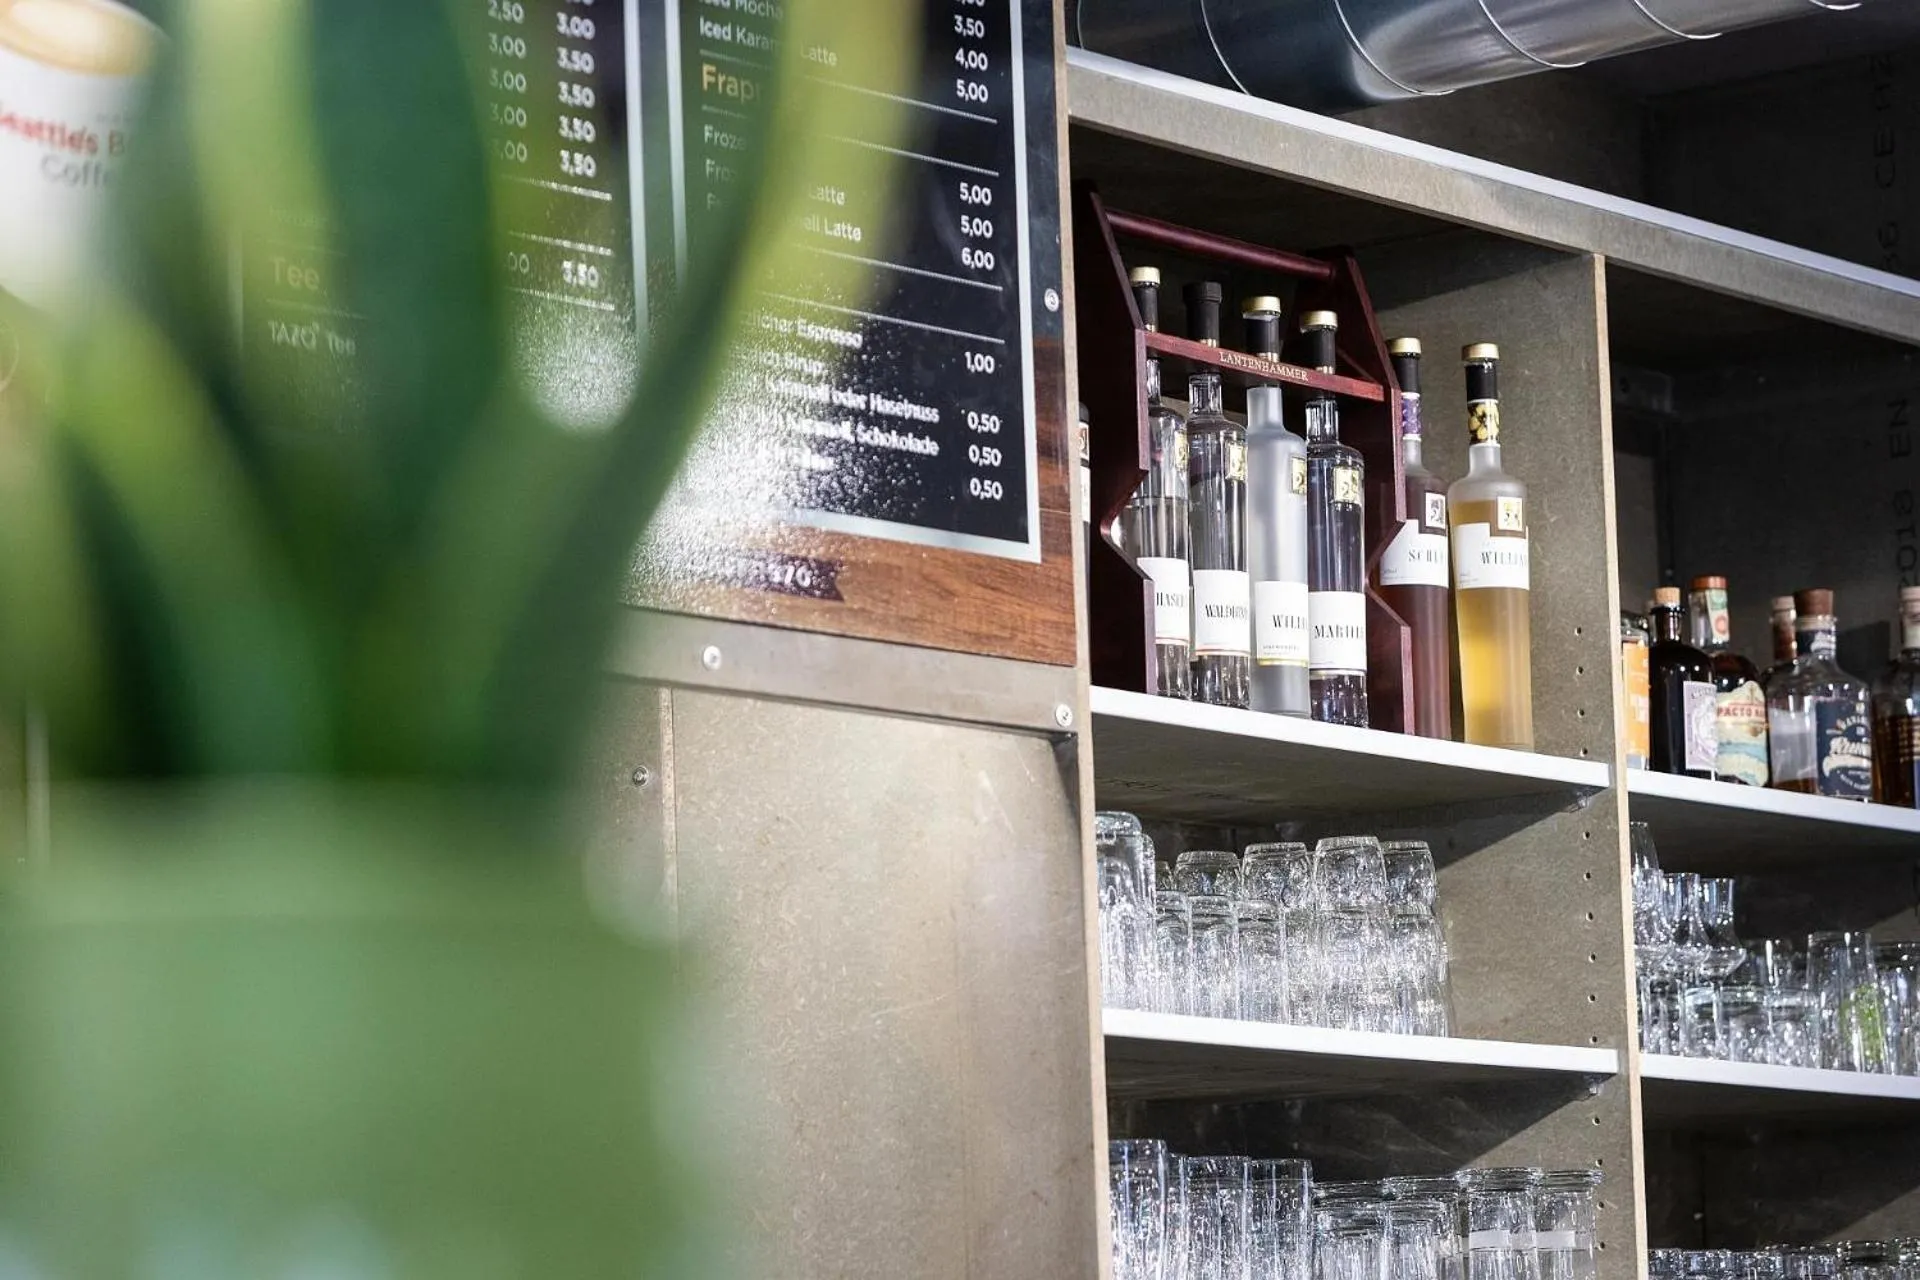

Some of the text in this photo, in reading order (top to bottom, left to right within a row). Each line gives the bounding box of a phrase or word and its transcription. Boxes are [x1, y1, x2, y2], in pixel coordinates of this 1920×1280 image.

[556, 11, 596, 40] 3,00
[699, 16, 732, 43] Iced
[954, 15, 986, 39] 3,50
[489, 31, 527, 59] 3,00
[800, 43, 838, 67] Latte
[557, 47, 595, 75] 3,50
[955, 48, 989, 73] 4,00
[489, 67, 528, 94] 3,00
[956, 79, 990, 104] 5,00
[558, 81, 596, 109] 3,50
[558, 115, 597, 143] 3,50
[559, 149, 597, 178] 3,50
[959, 182, 993, 207] 5,00
[824, 215, 863, 243] Latte
[960, 215, 994, 240] 5,00
[268, 255, 321, 291] Tee
[961, 247, 995, 272] 6,00
[797, 317, 864, 349] Espresso
[964, 351, 996, 375] 1,00
[1219, 351, 1310, 382] LANTENHAMMER
[832, 386, 868, 411] oder
[869, 392, 940, 424] Haselnuss
[966, 410, 1001, 435] 0,50
[855, 425, 940, 457] Schokolade
[968, 444, 1002, 469] 0,50
[969, 477, 1003, 502] 0,50
